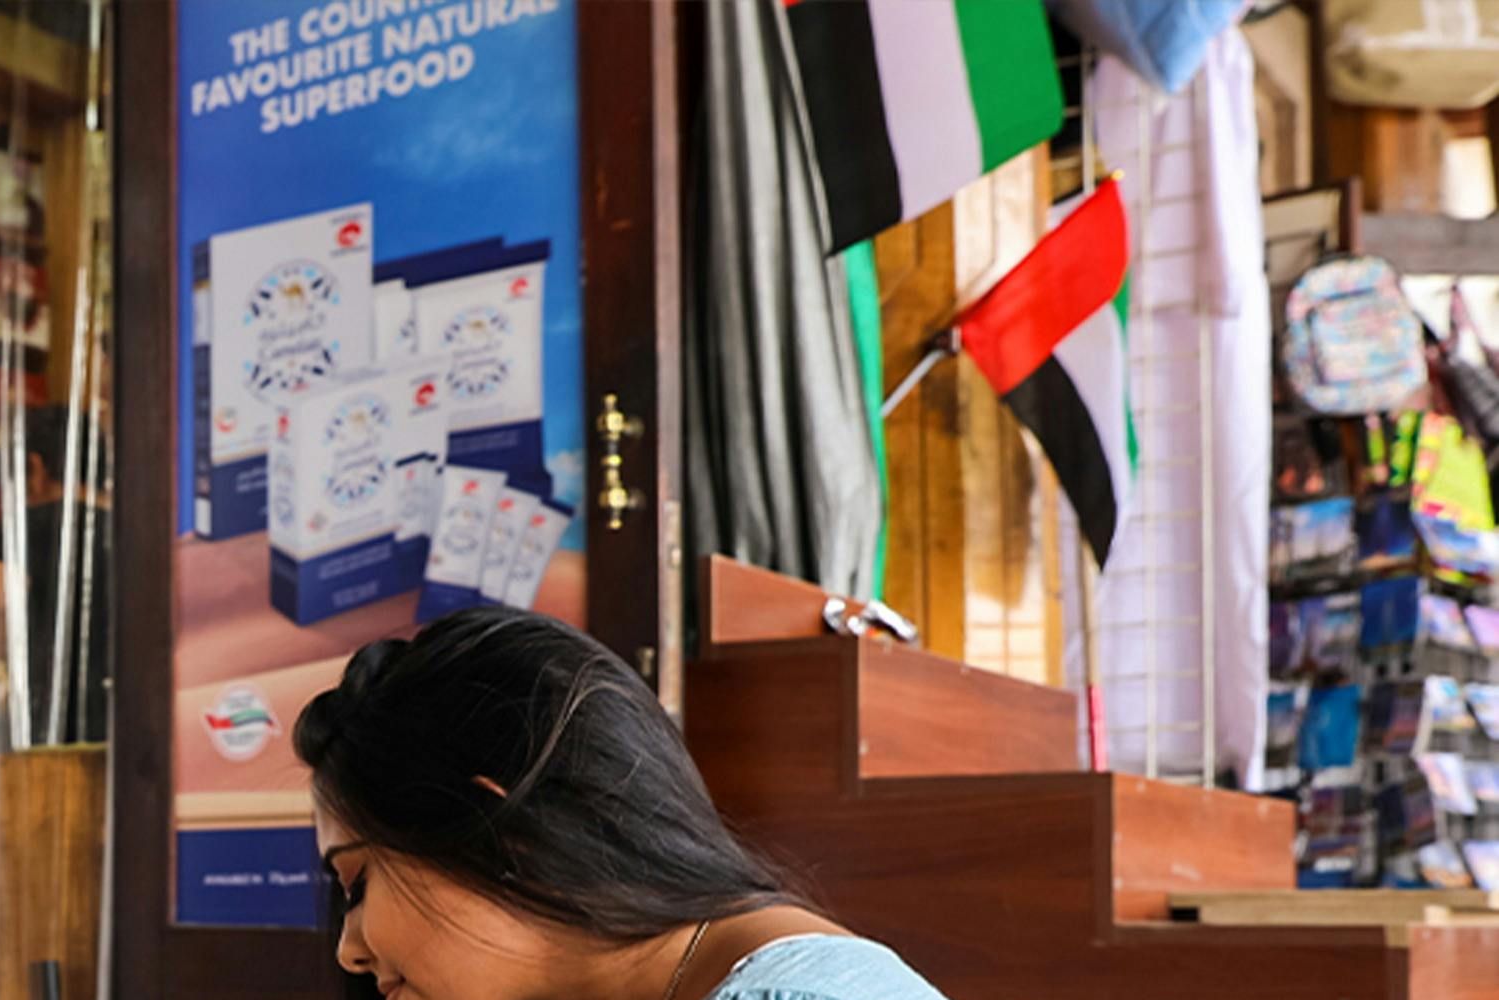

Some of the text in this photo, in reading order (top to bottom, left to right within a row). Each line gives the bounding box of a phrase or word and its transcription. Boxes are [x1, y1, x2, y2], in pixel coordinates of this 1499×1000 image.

[190, 32, 373, 116] FAVOURITE
[229, 18, 291, 66] THE
[259, 43, 475, 133] SUPERFOOD
